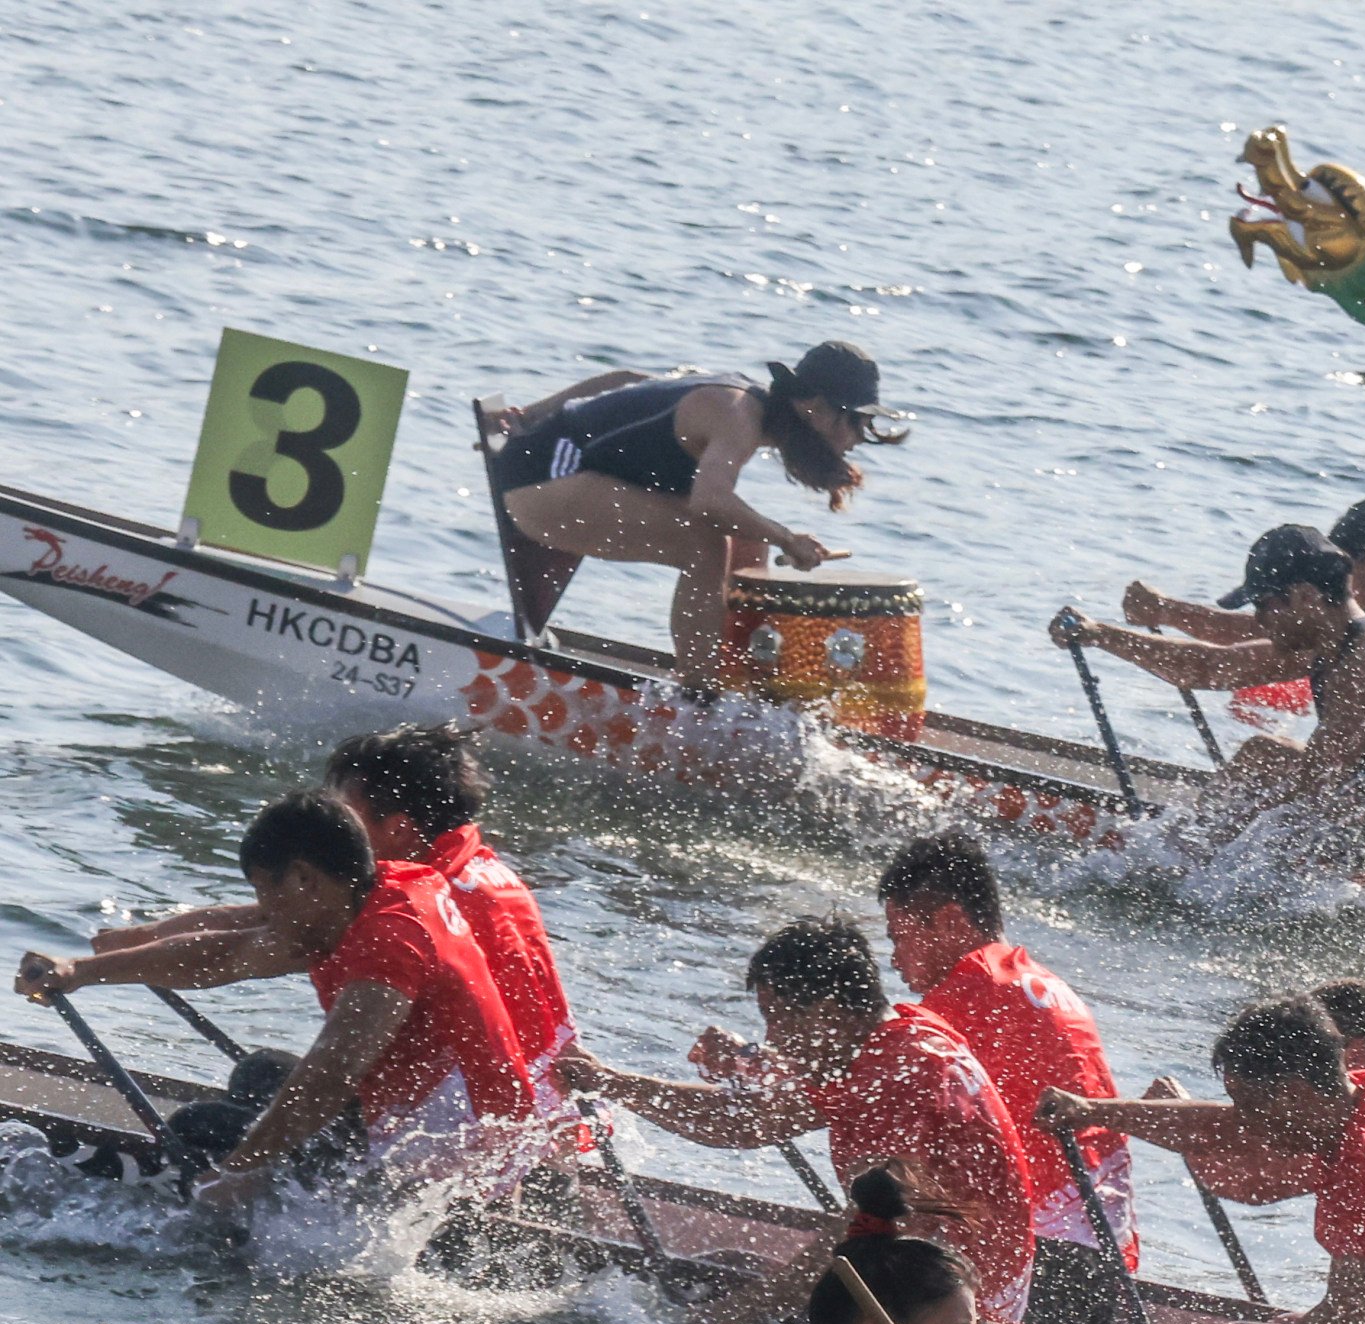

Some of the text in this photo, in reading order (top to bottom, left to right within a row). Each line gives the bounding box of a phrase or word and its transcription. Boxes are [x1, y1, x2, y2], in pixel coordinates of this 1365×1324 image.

[228, 361, 361, 532] 3
[247, 599, 421, 673] HKCDBA
[331, 661, 416, 699] 24-S37
